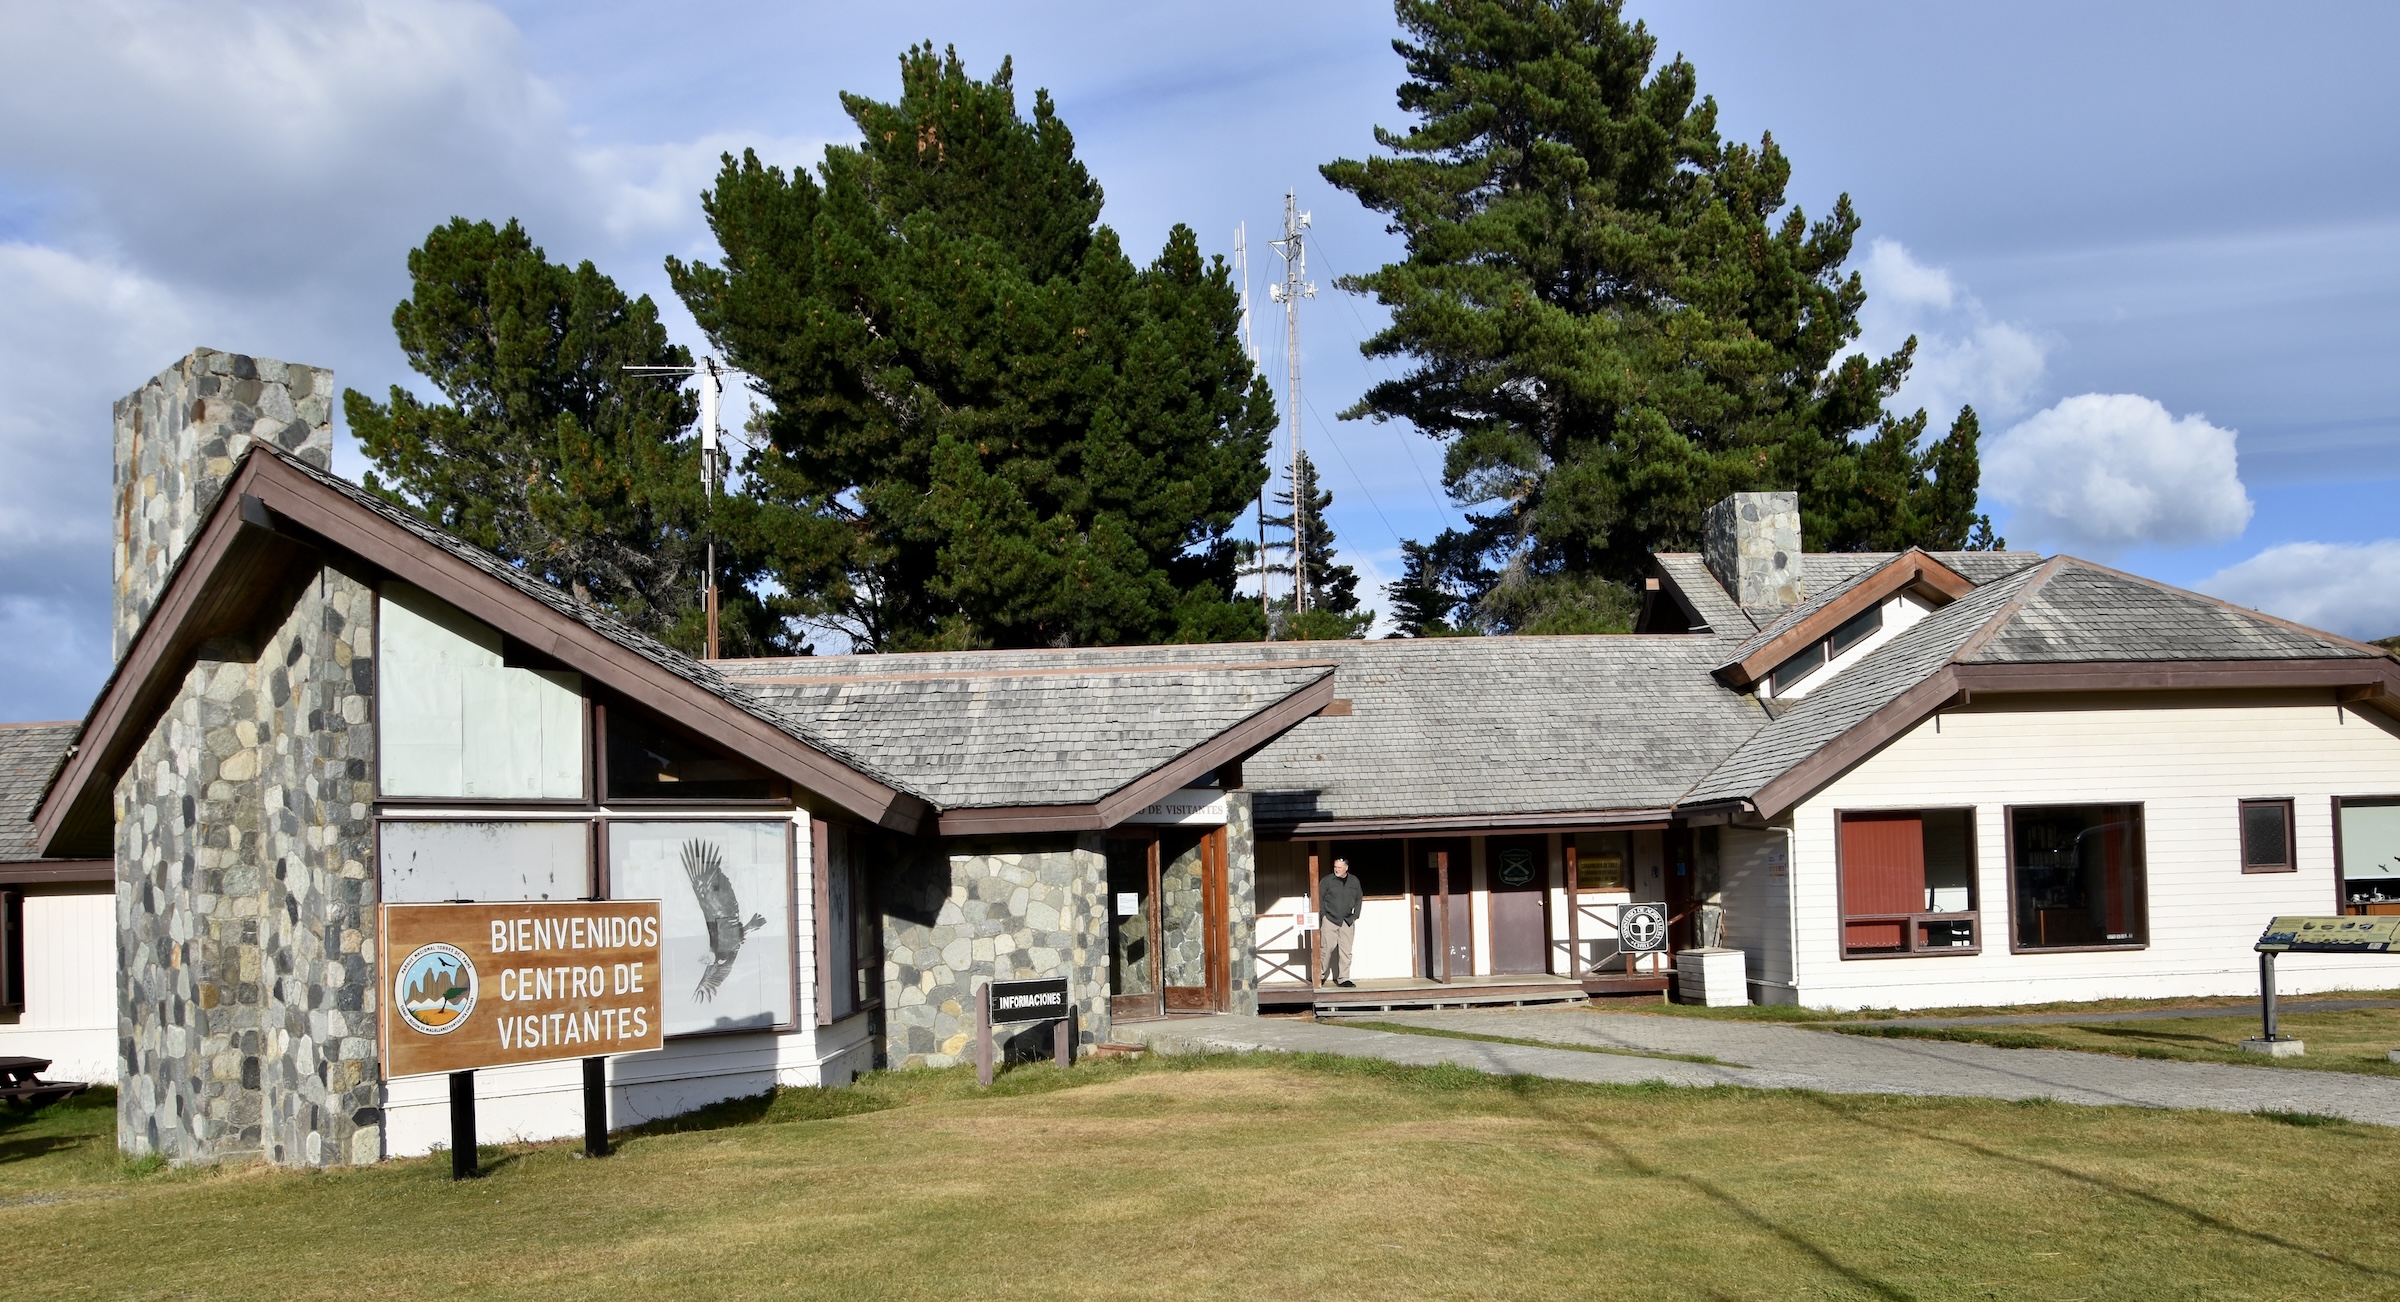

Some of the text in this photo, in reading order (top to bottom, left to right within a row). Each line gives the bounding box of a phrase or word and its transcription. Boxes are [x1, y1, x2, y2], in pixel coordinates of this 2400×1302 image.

[1148, 805, 1162, 815] DE
[1166, 805, 1223, 815] VISITANTES
[491, 916, 658, 953] BIENVENIDOS
[401, 945, 472, 974] PARQUE NACIONAL TORRES DEL PAINE
[500, 962, 644, 1001] CENTRO DE
[999, 992, 1061, 1009] INFORMACIONES
[497, 1006, 648, 1050] VISITANTES
